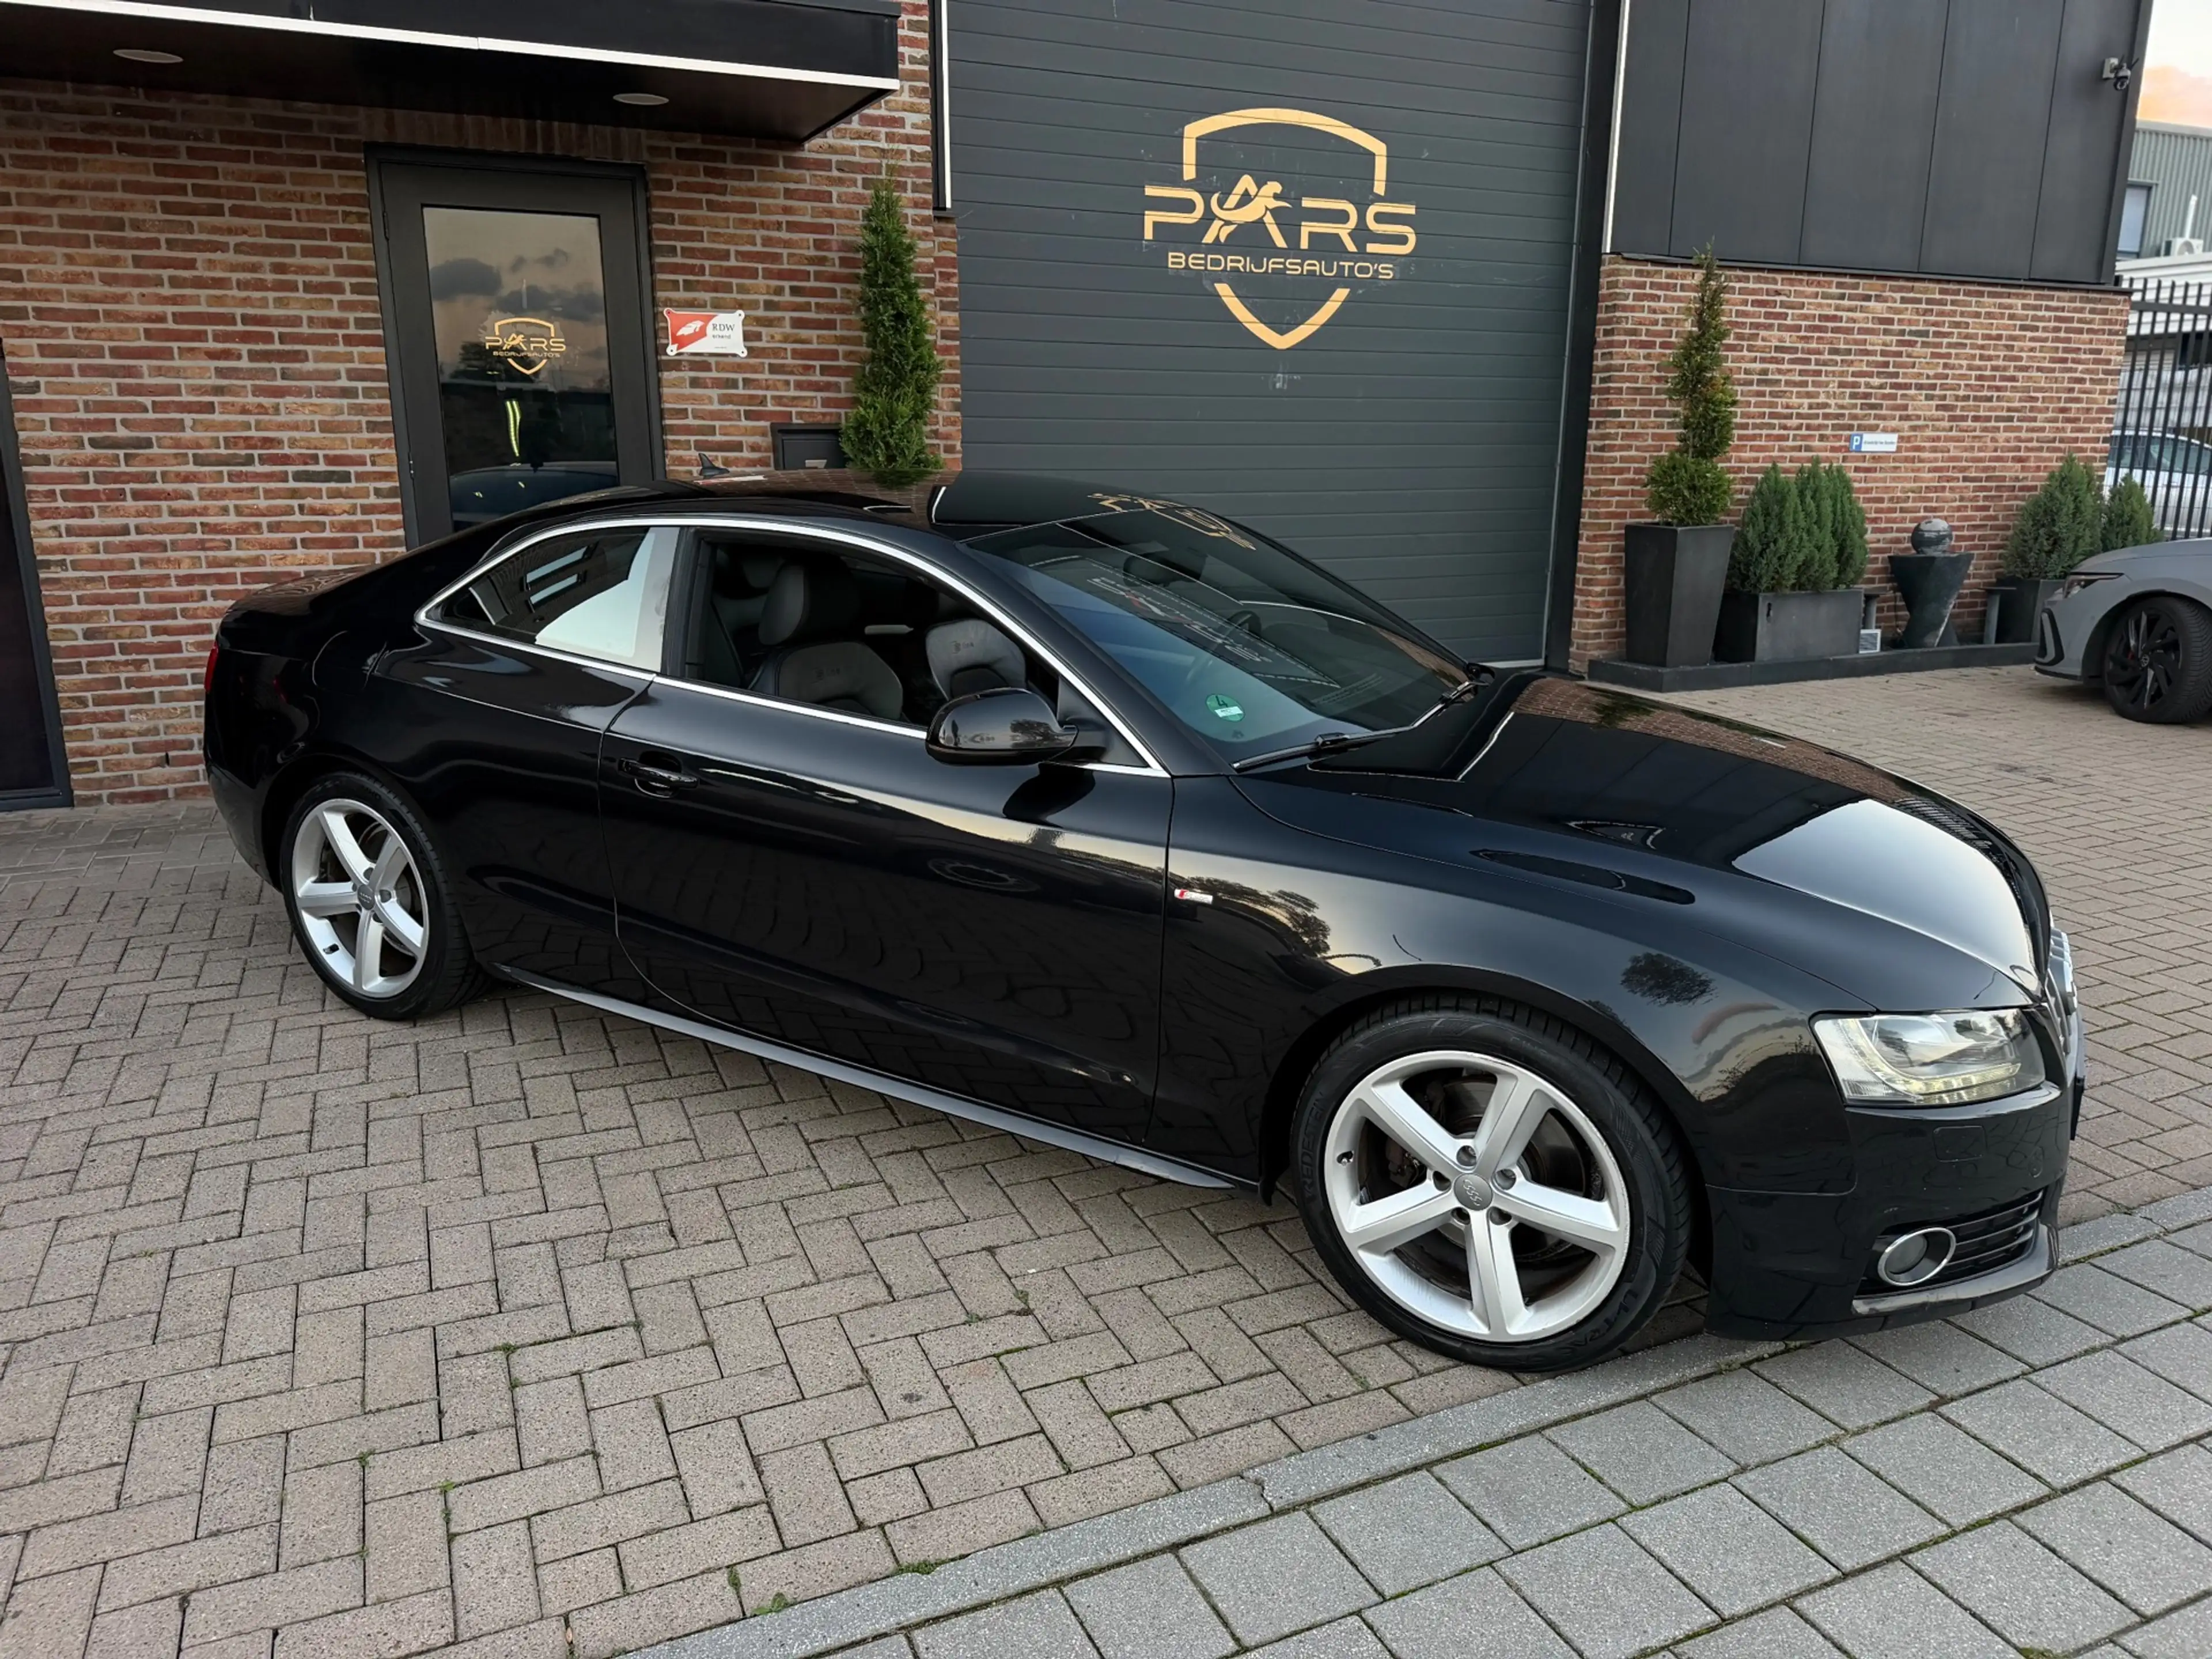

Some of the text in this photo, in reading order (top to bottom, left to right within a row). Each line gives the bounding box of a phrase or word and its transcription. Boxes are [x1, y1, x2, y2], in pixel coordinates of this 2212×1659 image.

[1144, 175, 1417, 255] PARS
[1168, 252, 1393, 279] BEDRIJFSAUTO'S
[712, 323, 735, 332] RDW
[485, 333, 566, 351] PARS
